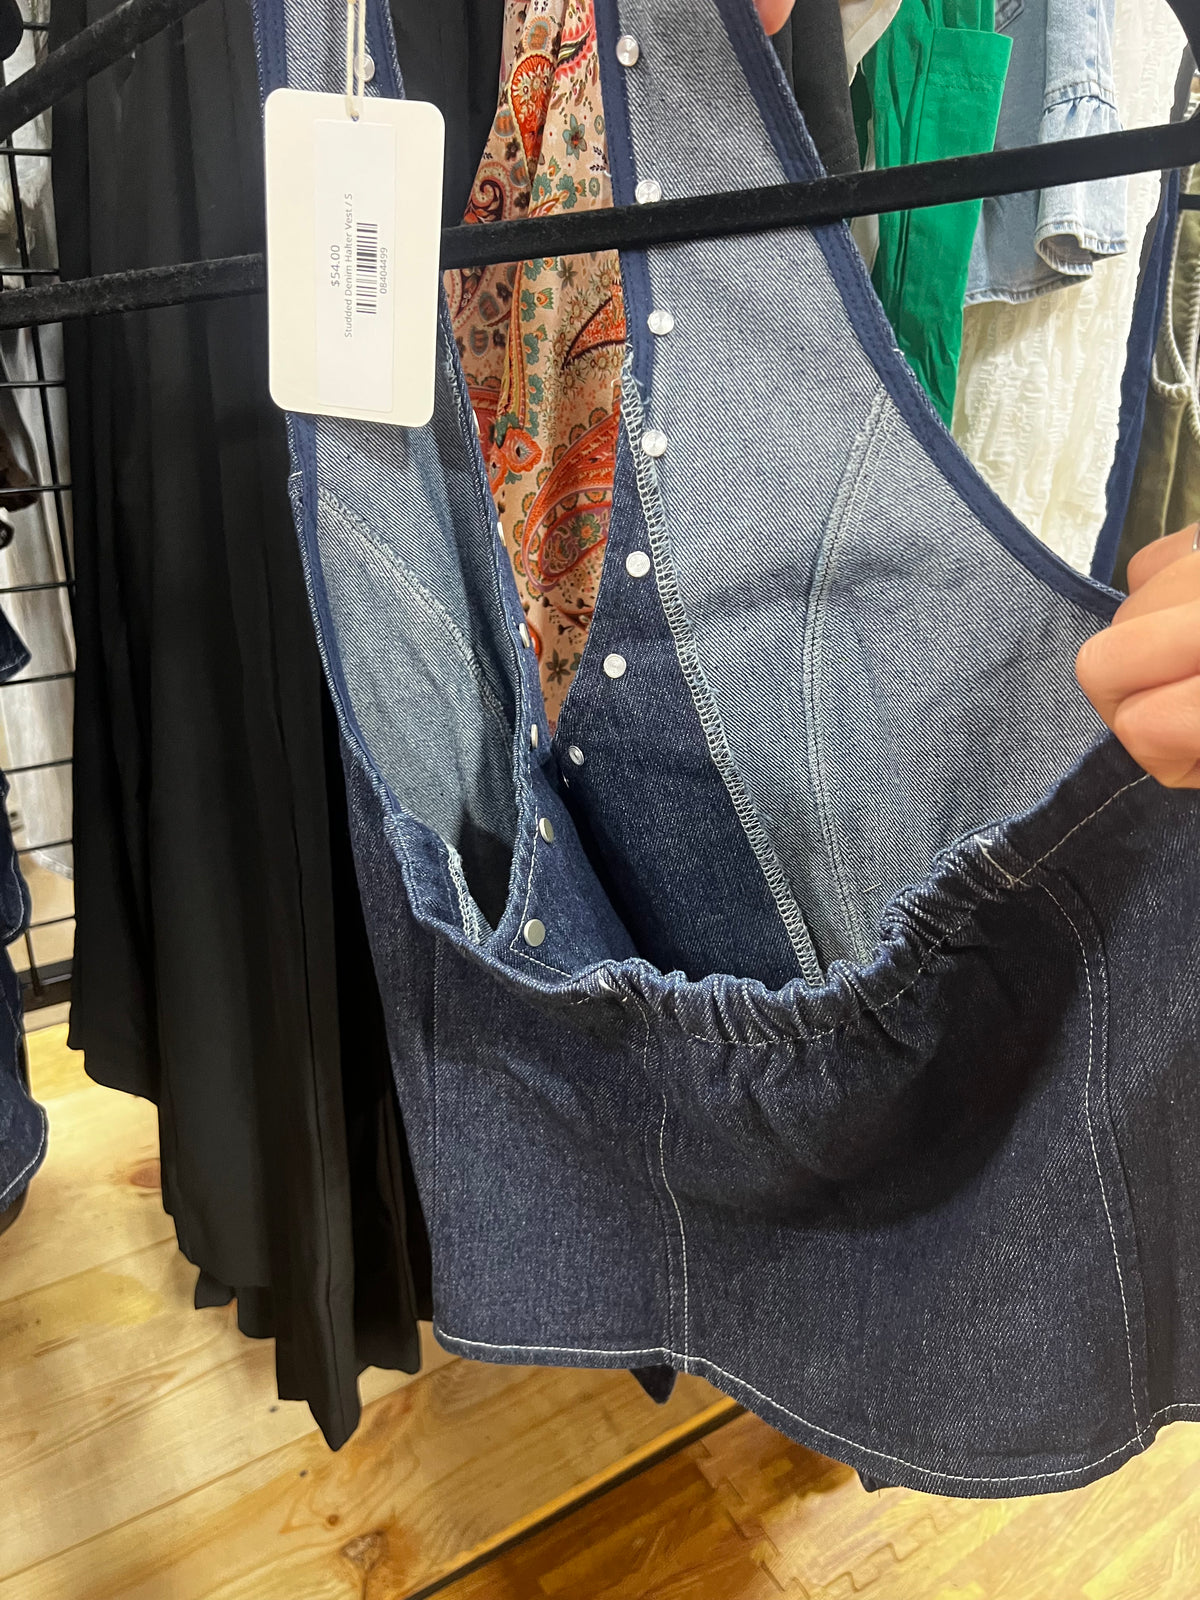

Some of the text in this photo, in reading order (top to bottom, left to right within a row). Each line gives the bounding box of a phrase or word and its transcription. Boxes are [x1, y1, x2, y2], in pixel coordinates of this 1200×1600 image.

[344, 209, 353, 230] Vest
[344, 232, 353, 262] Halter
[330, 244, 341, 287] $54.00
[344, 265, 353, 297] Denim
[379, 247, 388, 294] 08404499
[344, 298, 353, 338] Studded
